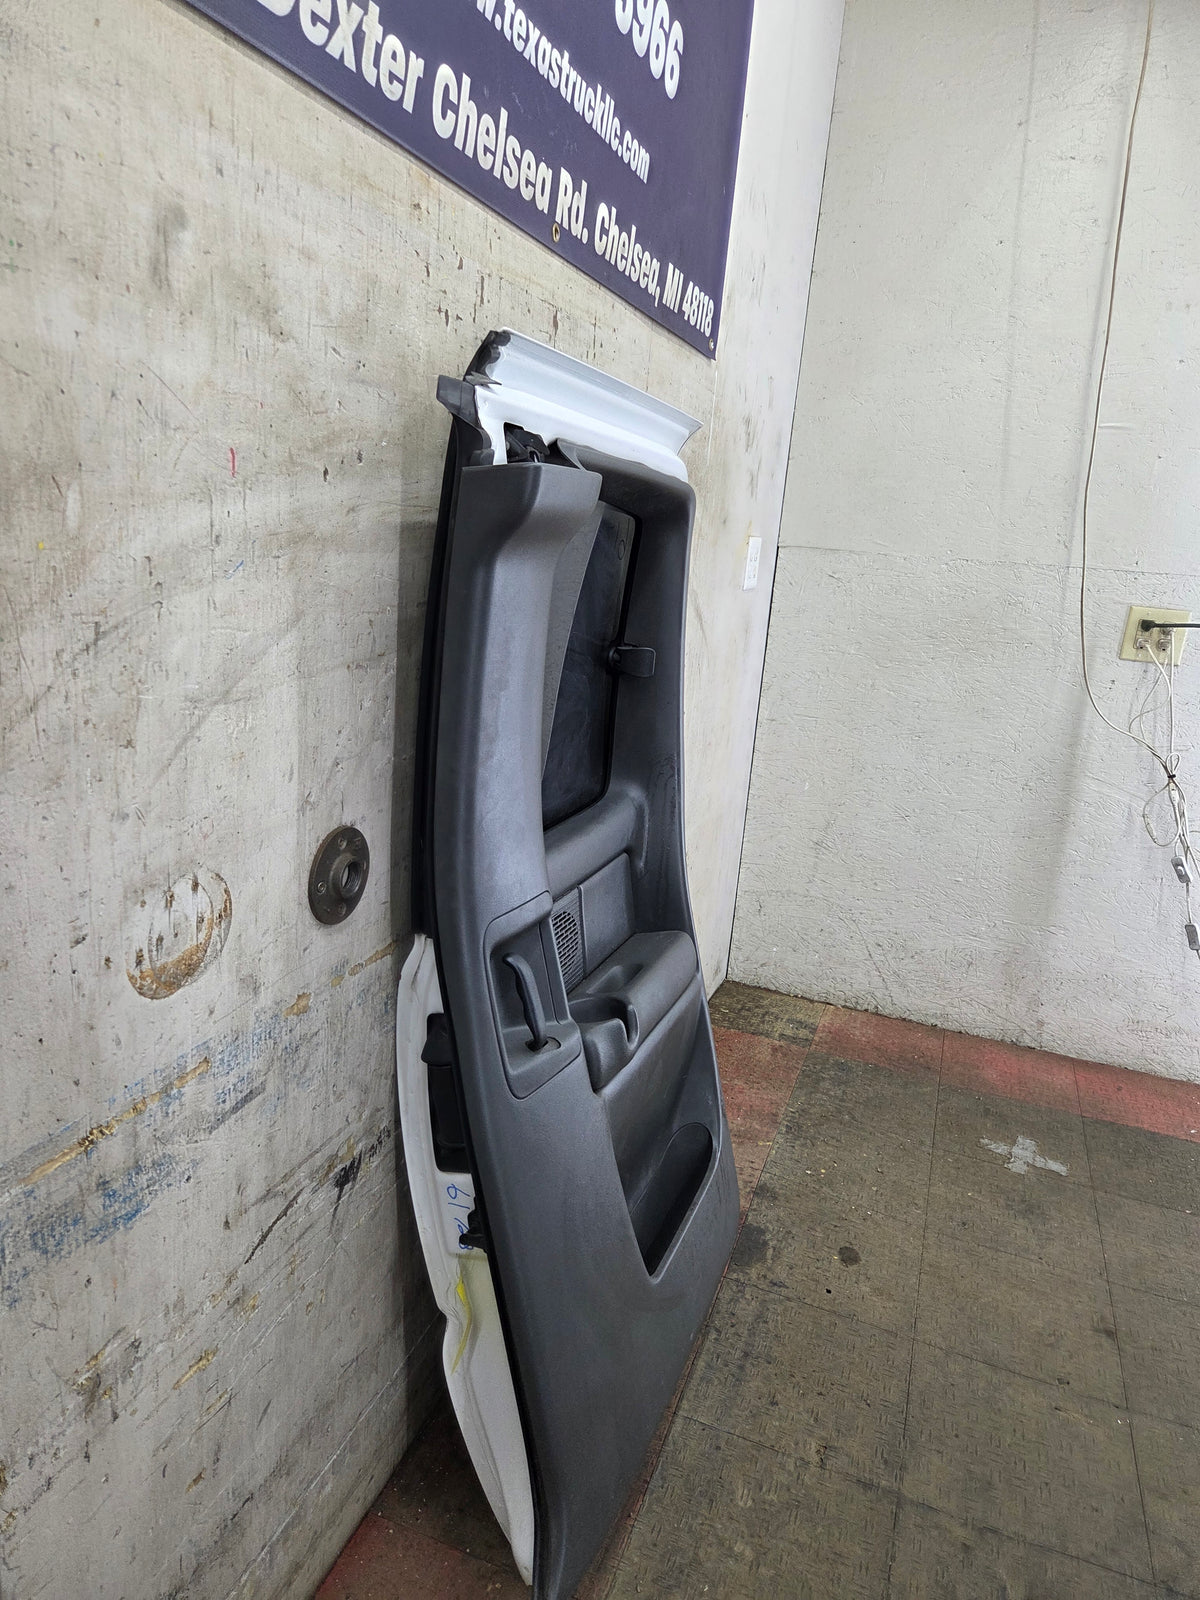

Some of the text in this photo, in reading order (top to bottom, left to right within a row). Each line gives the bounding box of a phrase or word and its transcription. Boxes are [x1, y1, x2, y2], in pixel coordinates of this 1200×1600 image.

[256, 0, 715, 338] exter Chelsea Rd. Chelsea, MI 48118
